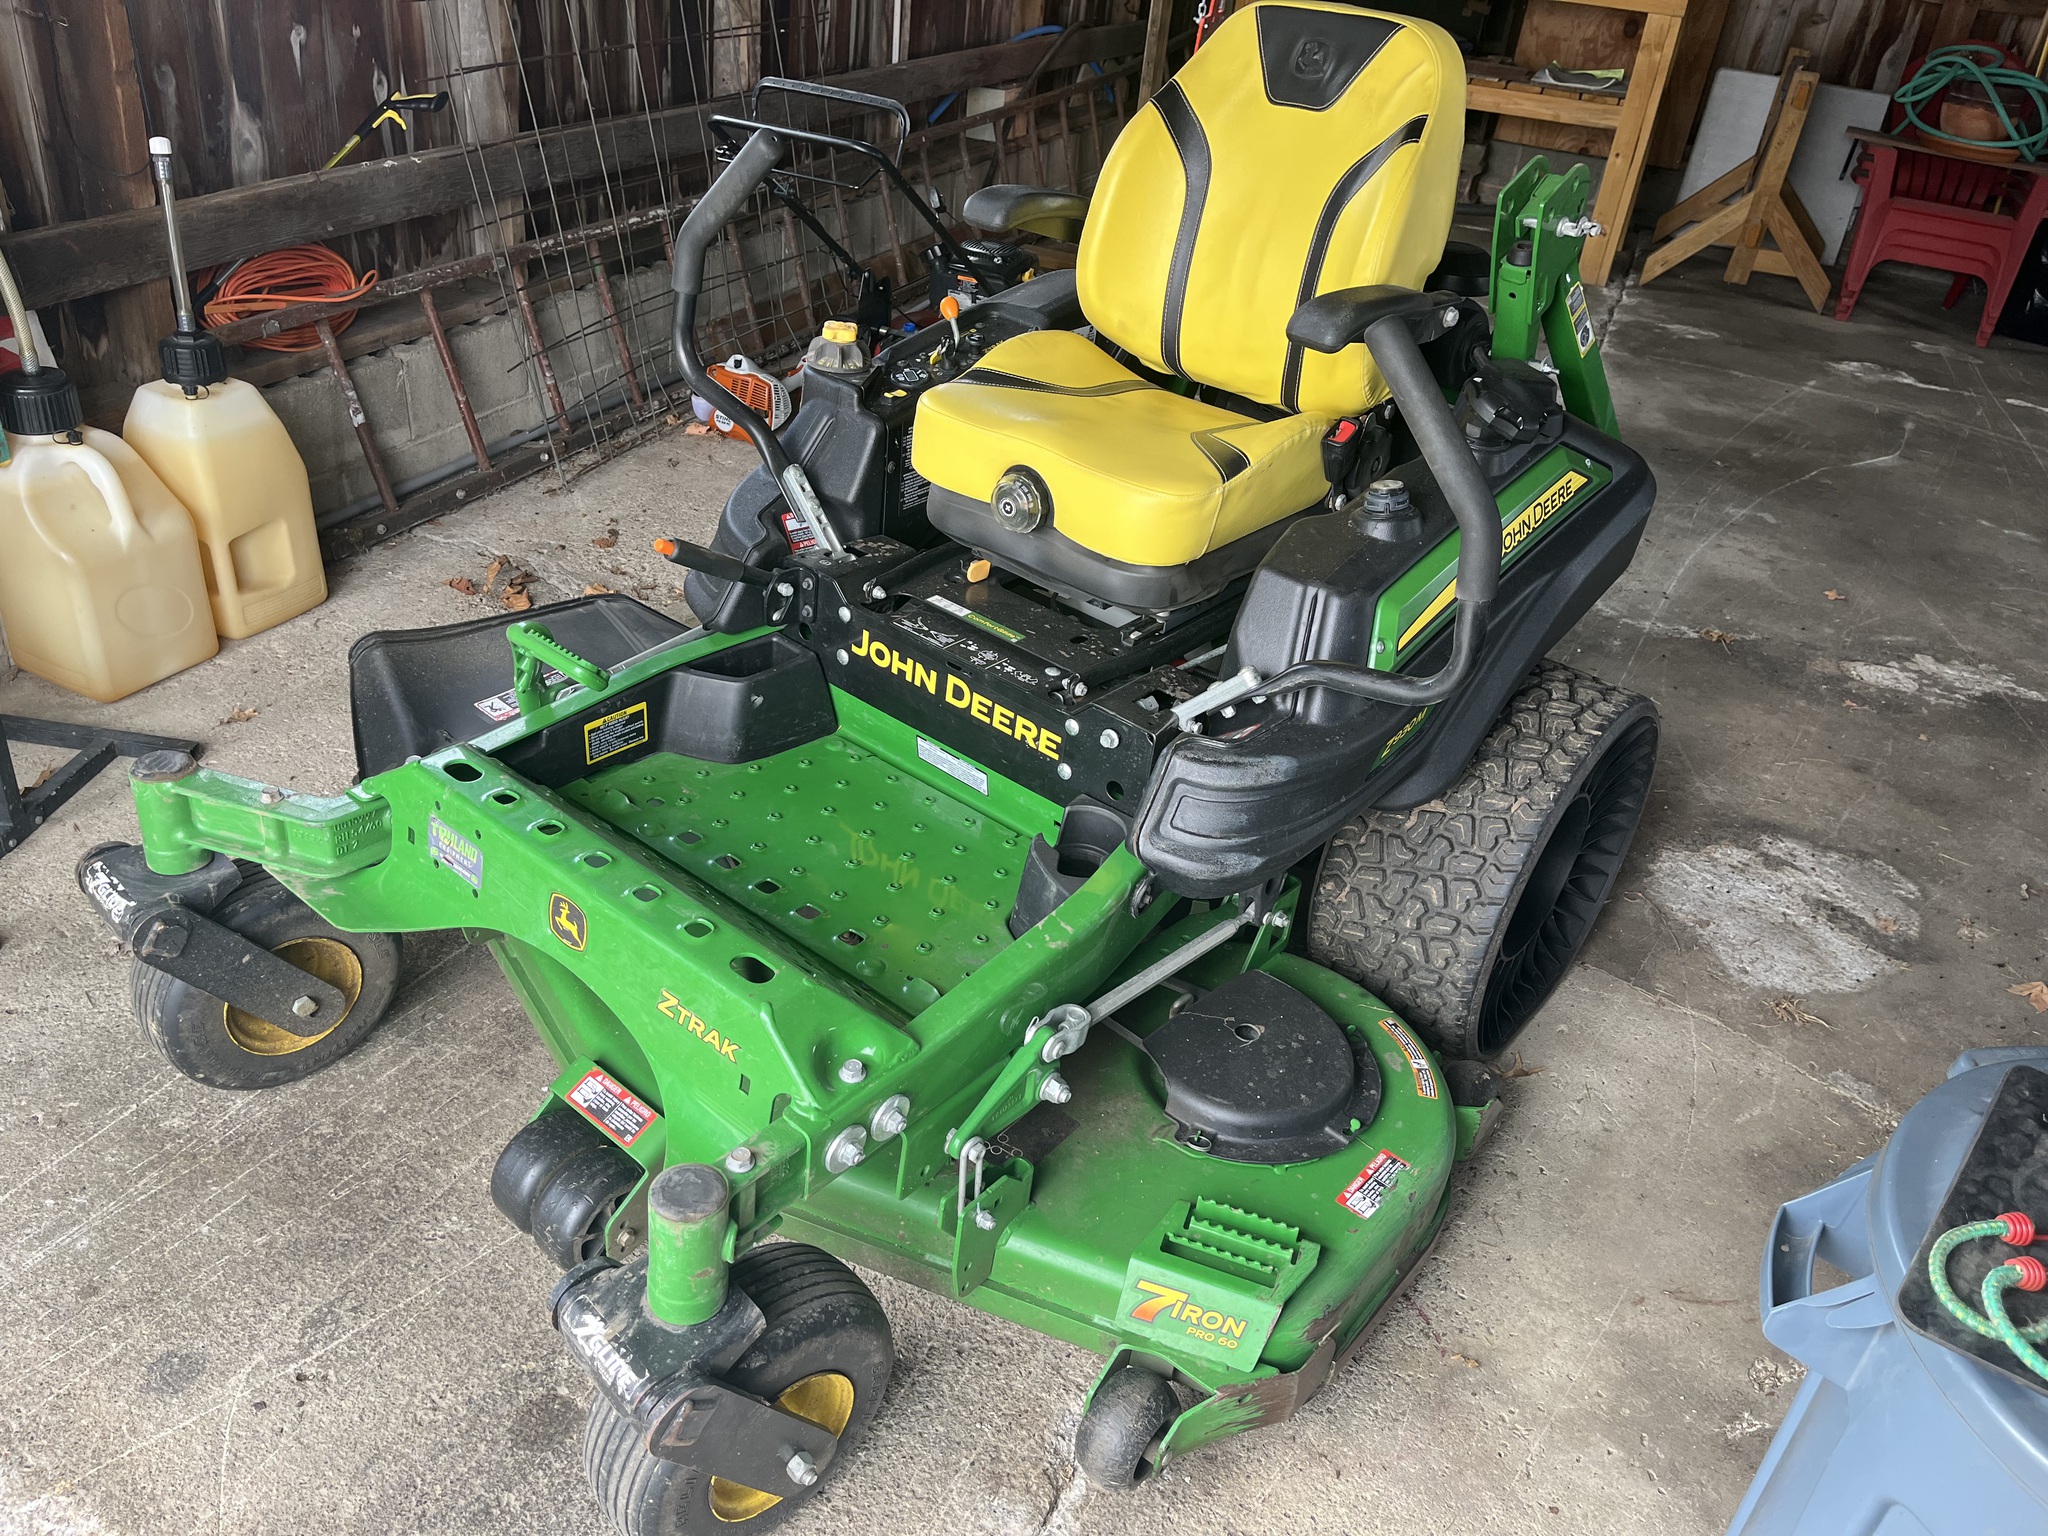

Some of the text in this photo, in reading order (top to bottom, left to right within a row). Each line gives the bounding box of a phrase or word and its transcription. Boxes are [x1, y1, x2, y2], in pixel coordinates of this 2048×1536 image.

[1502, 478, 1573, 551] OHN DEERE
[851, 629, 1063, 761] JOHN DEERE
[606, 710, 628, 722] CAUTION
[656, 988, 742, 1065] ZTRAK
[601, 1078, 622, 1095] DANGER
[630, 1099, 652, 1118] PELIGRO
[1346, 1176, 1365, 1193] DANGER
[1369, 1152, 1387, 1169] PELIGRO
[1185, 1326, 1239, 1349] PRO 60
